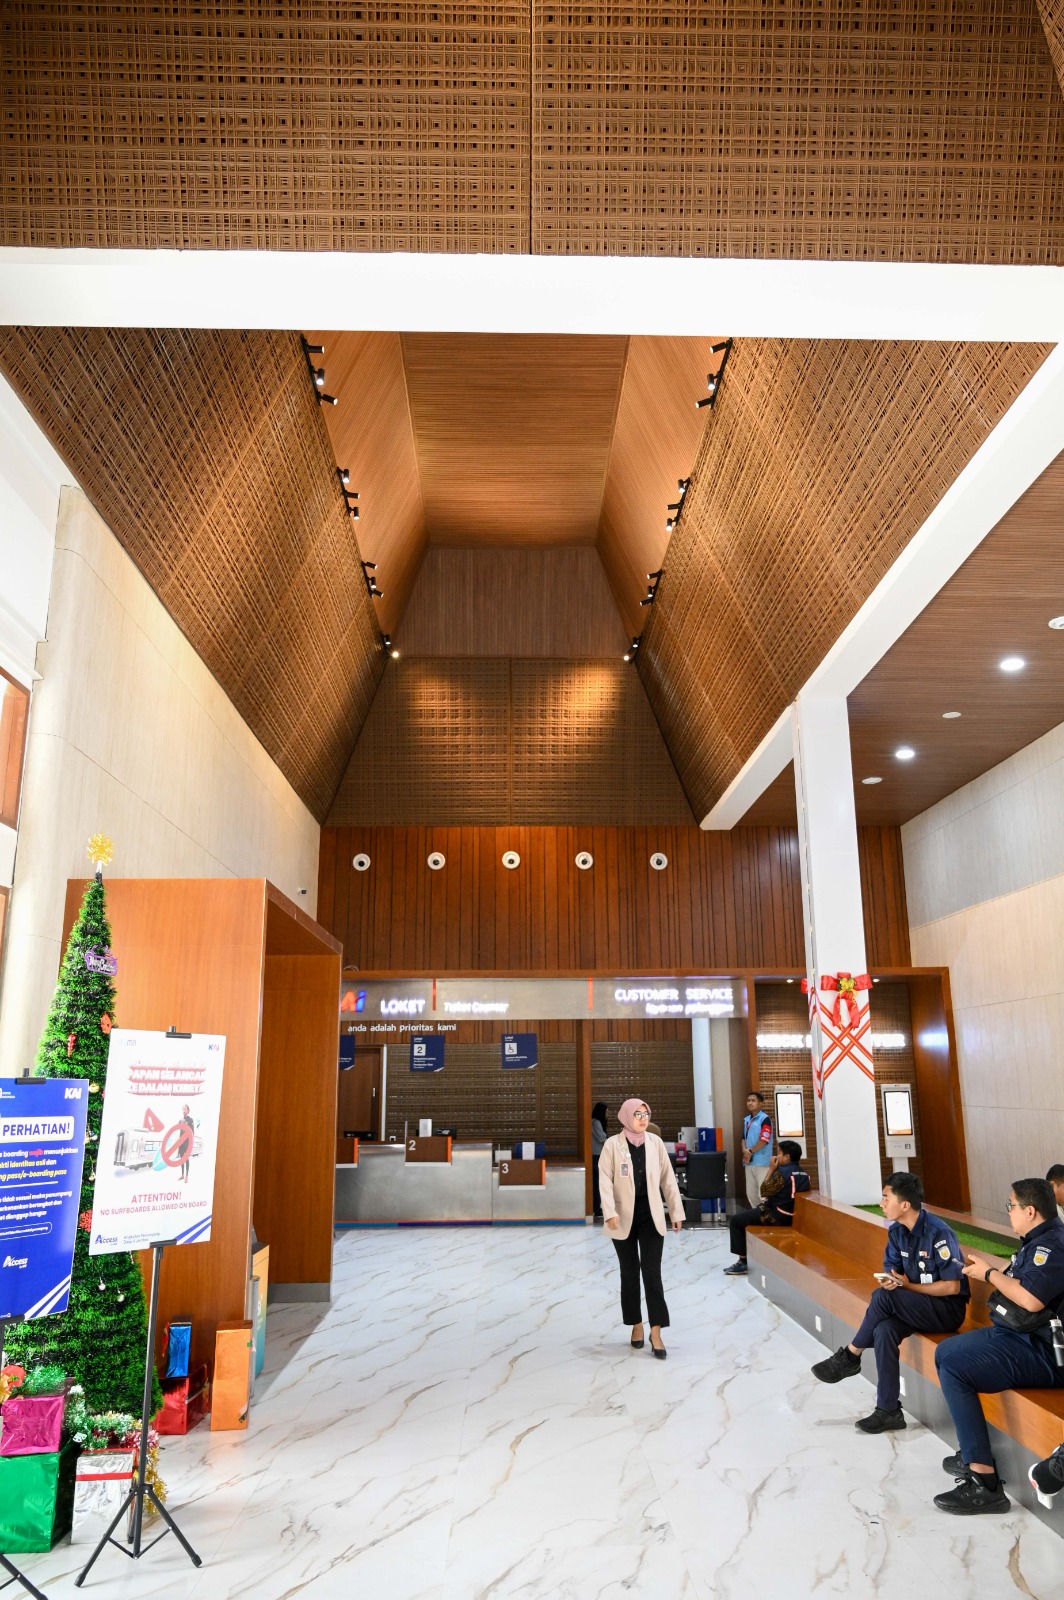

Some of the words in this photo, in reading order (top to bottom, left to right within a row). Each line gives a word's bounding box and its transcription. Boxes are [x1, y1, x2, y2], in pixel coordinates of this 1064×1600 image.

[614, 988, 679, 1000] CUSTOMER
[686, 988, 733, 1000] SERVICE
[380, 999, 425, 1013] LOKET
[347, 1024, 367, 1032] anda
[370, 1023, 397, 1032] adalah
[399, 1023, 434, 1033] prioritas
[437, 1023, 457, 1031] kami
[417, 1046, 423, 1054] 2
[64, 1087, 82, 1099] KAI
[2, 1122, 71, 1137] PERHATIAN!
[700, 1130, 706, 1141] 1
[408, 1139, 416, 1151] 2
[501, 1163, 509, 1174] 3
[131, 1191, 182, 1204] ATTENTION!
[100, 1208, 109, 1216] NO
[111, 1205, 151, 1215] SURFBOARDS
[151, 1203, 178, 1211] ALLOWED
[188, 1200, 208, 1208] BOARD
[3, 1255, 28, 1268] Access
